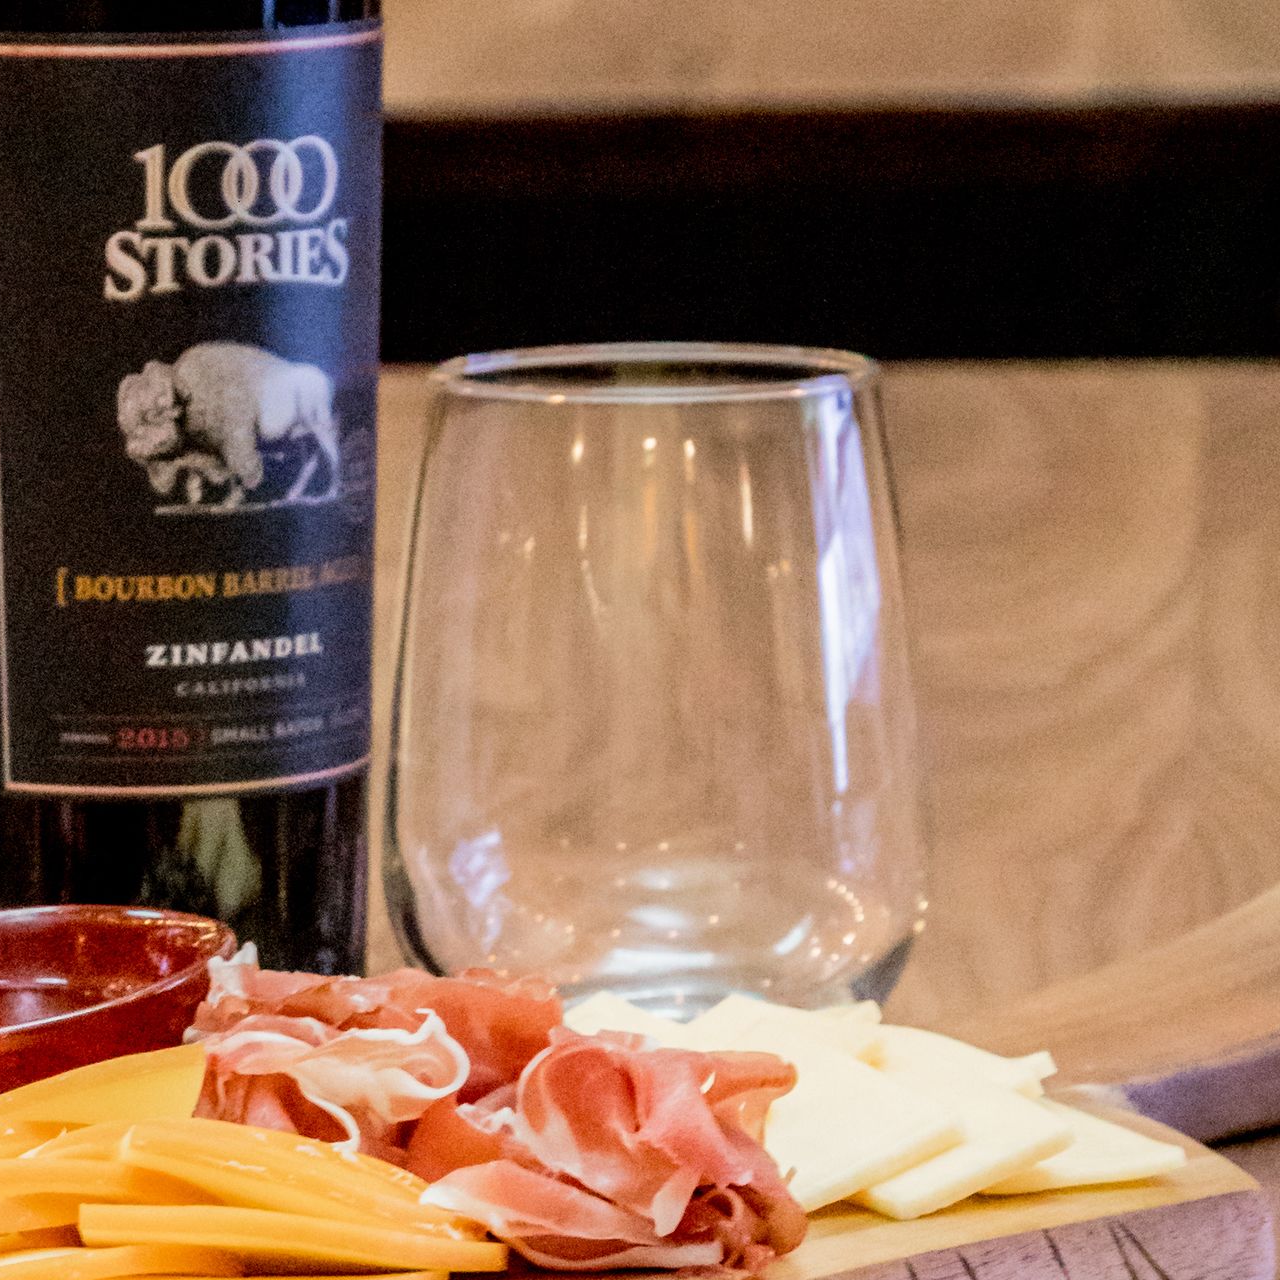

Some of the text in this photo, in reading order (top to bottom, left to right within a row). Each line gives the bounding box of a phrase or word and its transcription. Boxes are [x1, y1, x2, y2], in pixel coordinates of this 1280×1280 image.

[133, 135, 338, 230] 1000
[104, 219, 349, 302] STORIES
[74, 572, 217, 602] BOURBON
[145, 631, 323, 668] ZINFANDEL
